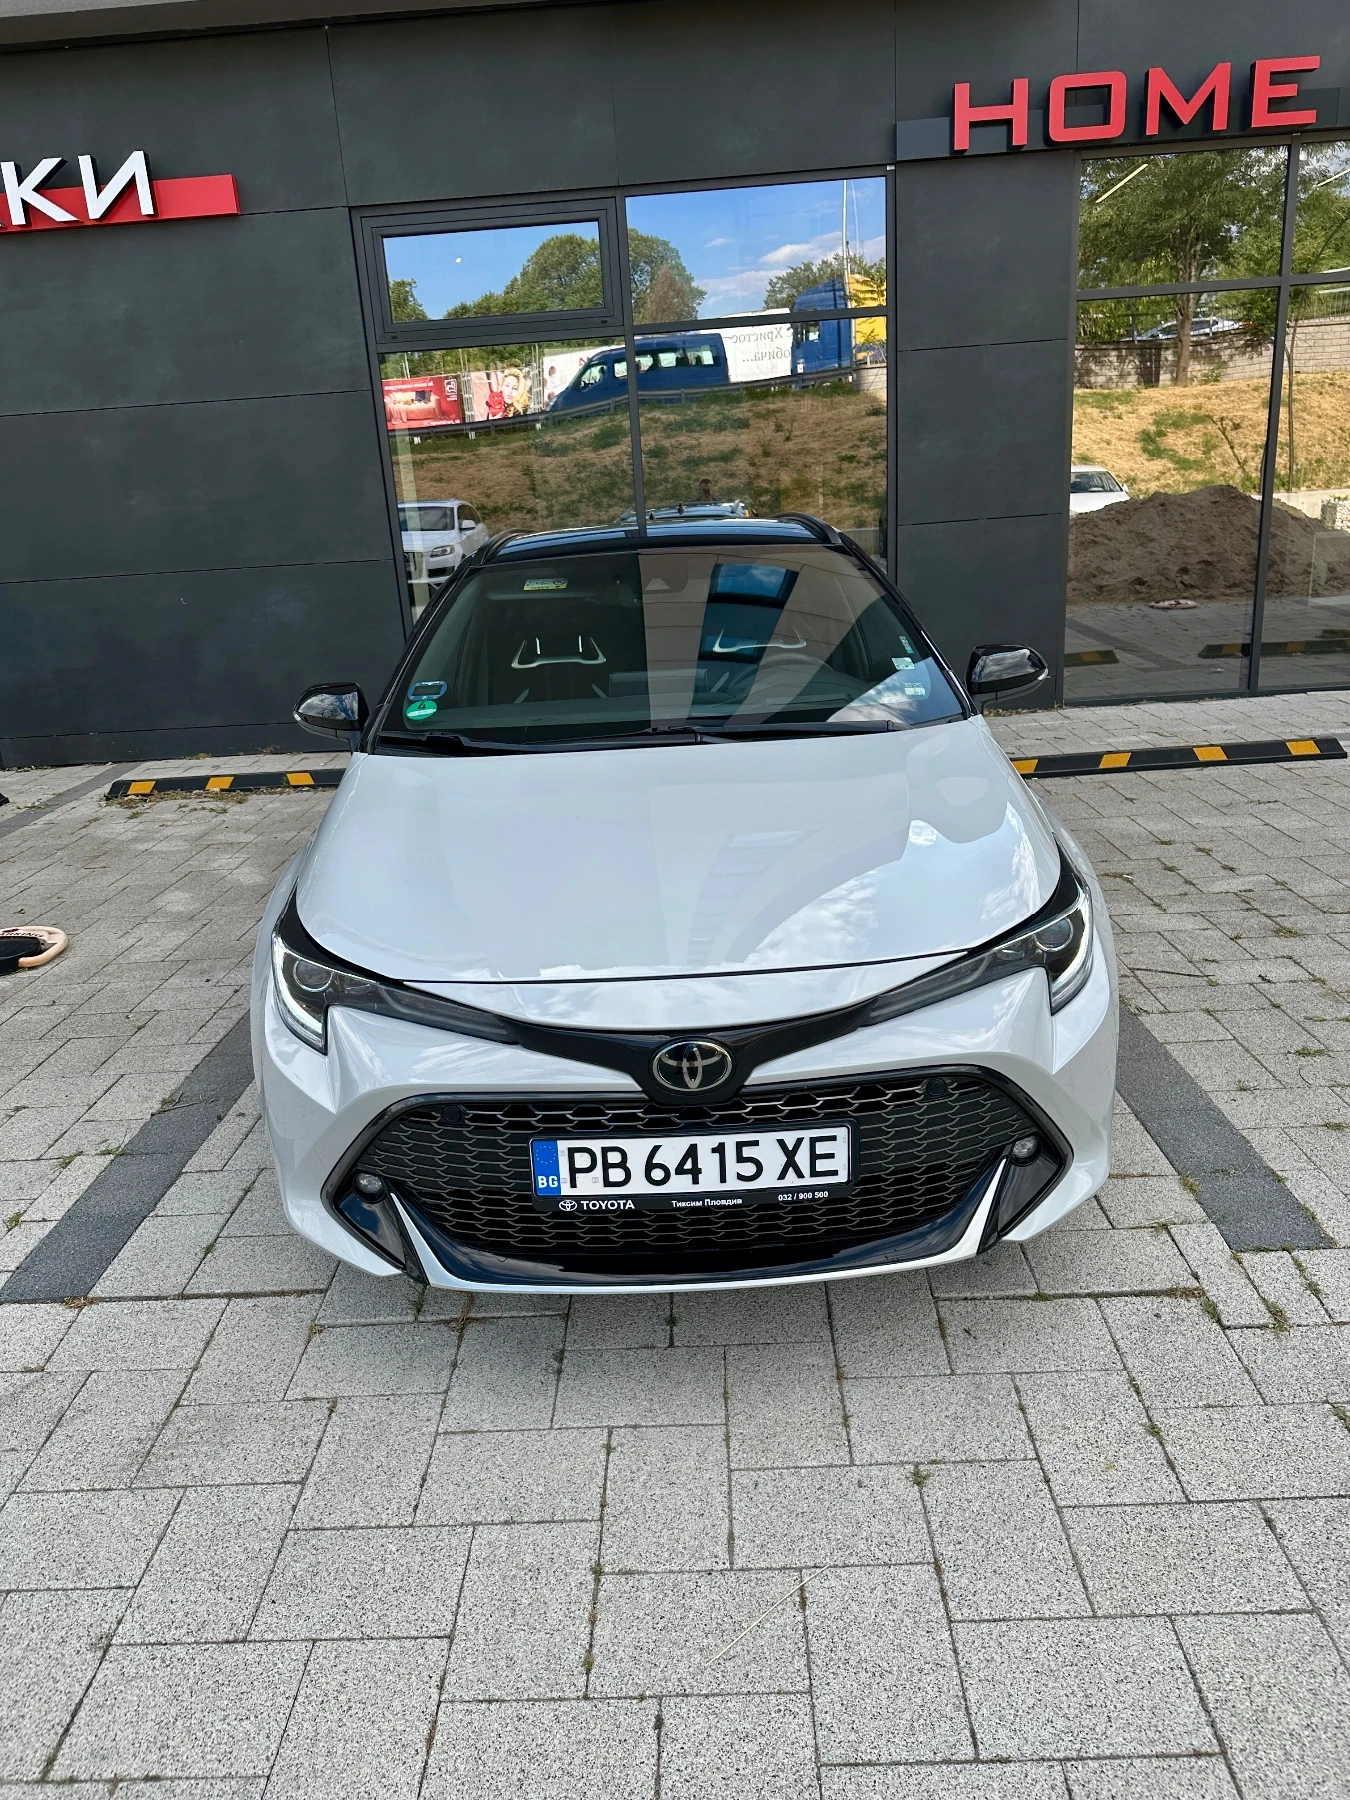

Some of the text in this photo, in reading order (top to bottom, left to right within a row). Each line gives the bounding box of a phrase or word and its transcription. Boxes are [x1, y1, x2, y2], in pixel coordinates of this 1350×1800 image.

[953, 55, 1321, 151] HOME
[0, 150, 154, 227] КИ
[567, 1134, 839, 1189] PB 6415 XE
[538, 1175, 559, 1188] BG
[778, 1193, 792, 1201] 032
[798, 1192, 813, 1200] 900
[814, 1191, 829, 1199] 500
[581, 1200, 636, 1210] TOYOTA
[671, 1198, 743, 1208] Тиксим Пловдив
